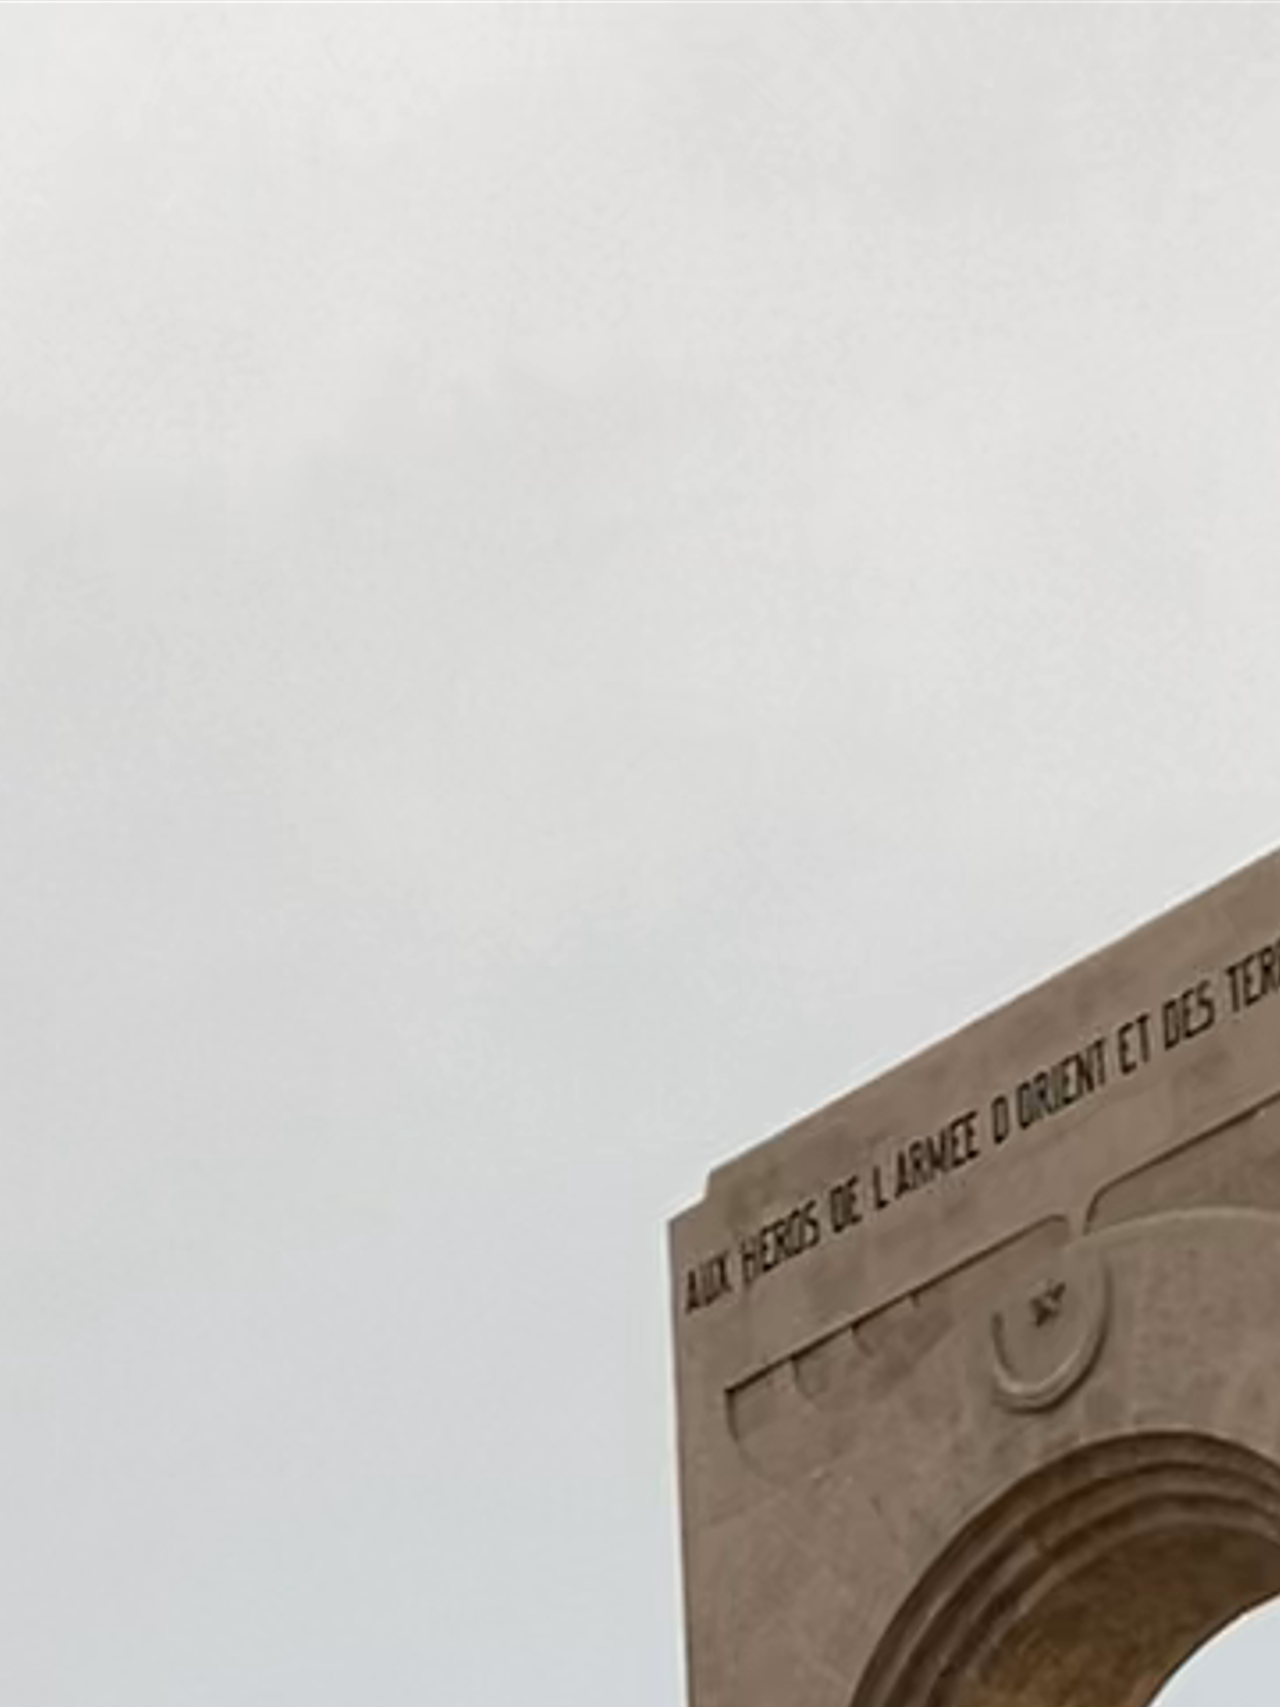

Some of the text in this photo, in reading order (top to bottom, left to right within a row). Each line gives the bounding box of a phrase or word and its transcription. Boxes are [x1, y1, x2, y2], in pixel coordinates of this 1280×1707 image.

[685, 1250, 733, 1314] AUX
[737, 1199, 821, 1288] HEROS
[828, 1175, 863, 1233] DE
[1117, 1012, 1152, 1075] ET
[1162, 979, 1215, 1051] DES
